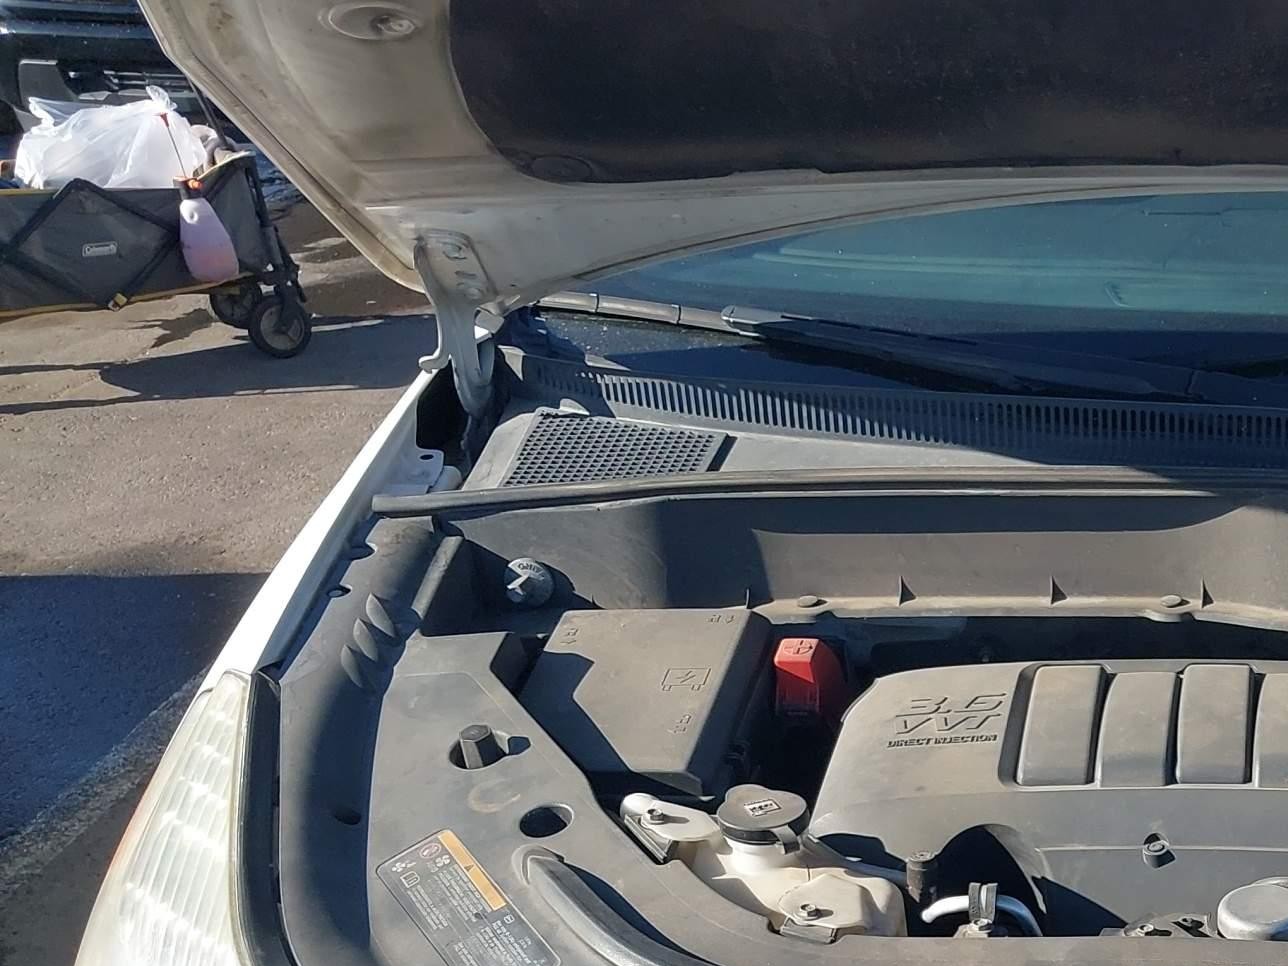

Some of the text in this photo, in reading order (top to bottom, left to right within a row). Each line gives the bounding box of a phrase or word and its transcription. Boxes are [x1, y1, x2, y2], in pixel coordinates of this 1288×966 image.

[896, 692, 1007, 717] 3.6
[895, 714, 1001, 735] VVT
[887, 735, 998, 748] DIRECT INJECTION
